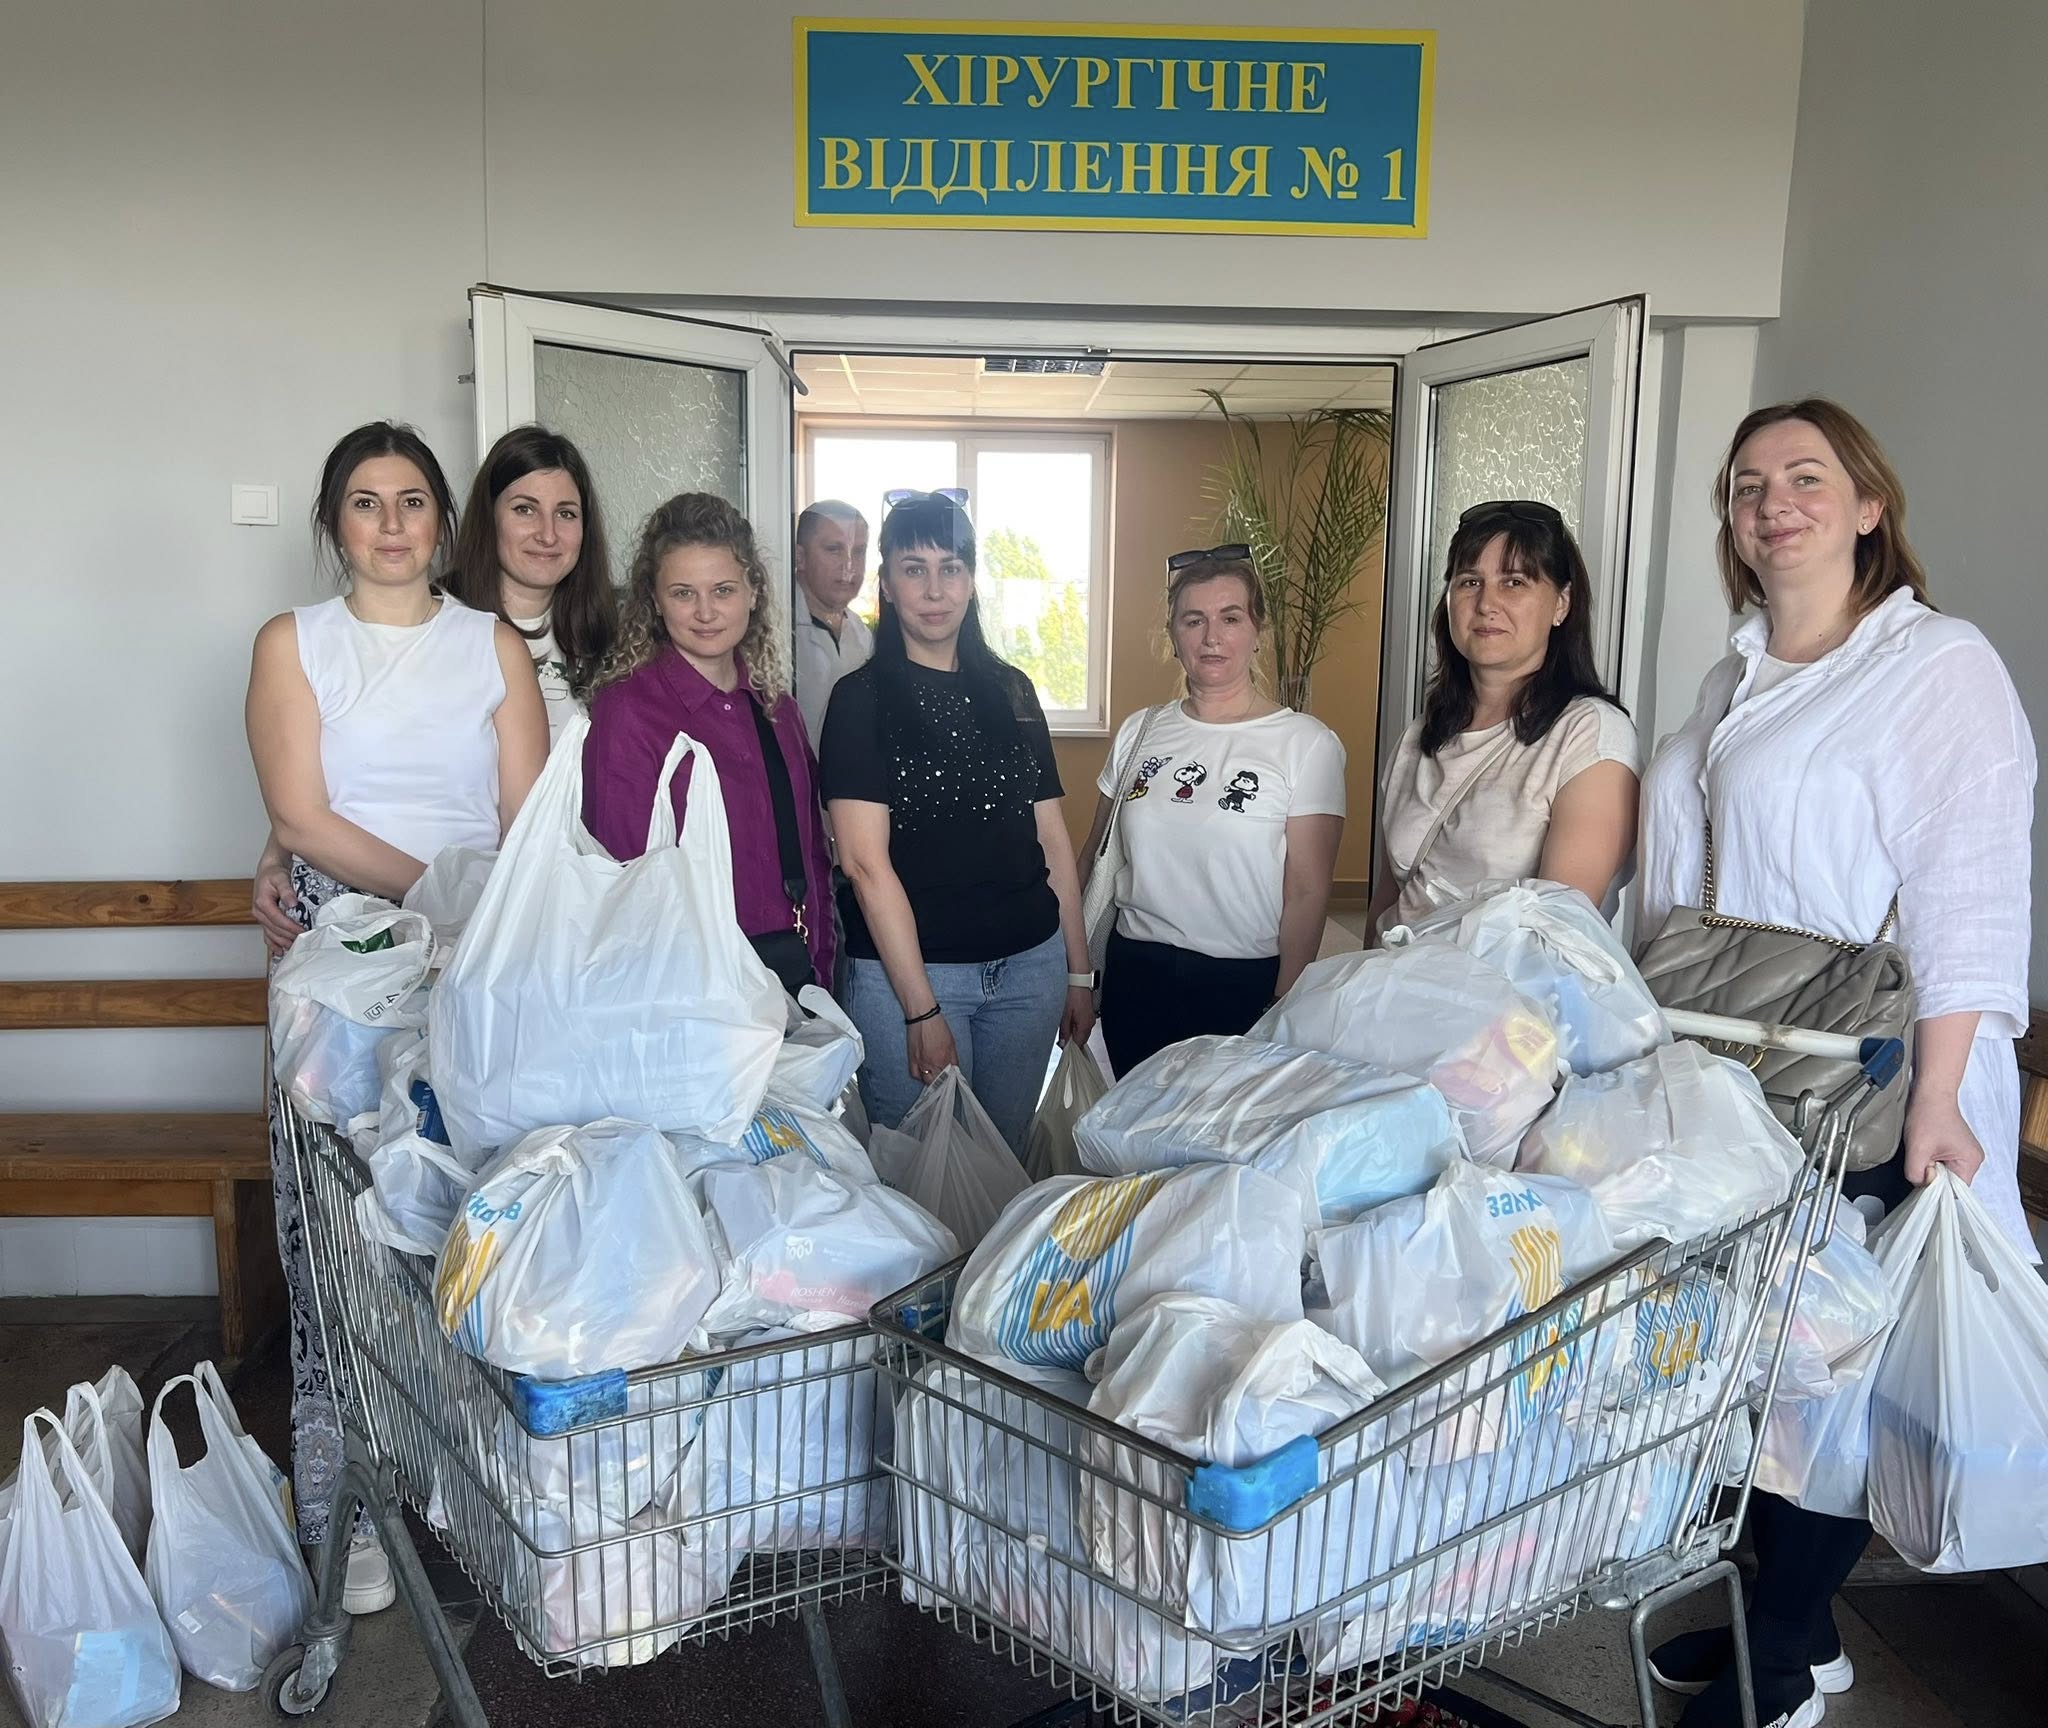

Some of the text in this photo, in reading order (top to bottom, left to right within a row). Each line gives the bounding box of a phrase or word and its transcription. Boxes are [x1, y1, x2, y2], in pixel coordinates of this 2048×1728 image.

[903, 53, 1327, 113] ХІРУРГІЧНЕ
[818, 136, 1407, 205] ВІДДІЛЕННЯ № 1
[1028, 1279, 1096, 1333] UA
